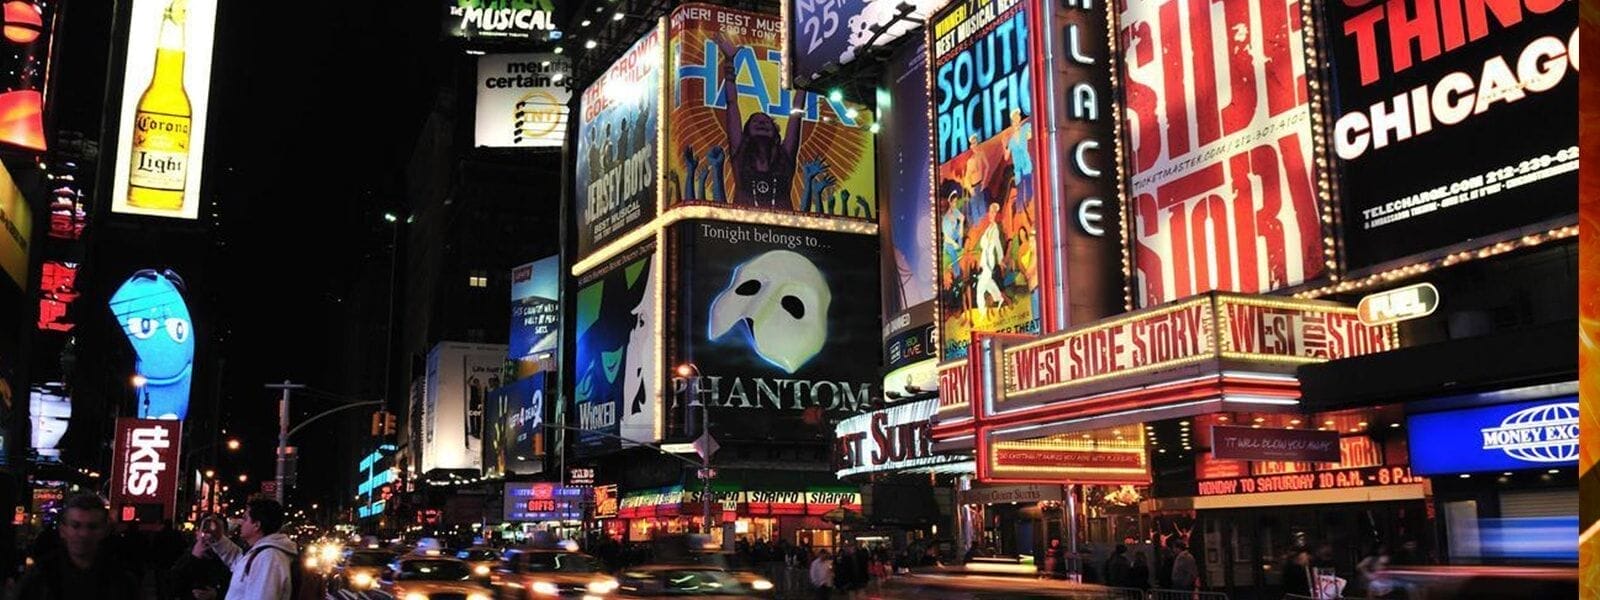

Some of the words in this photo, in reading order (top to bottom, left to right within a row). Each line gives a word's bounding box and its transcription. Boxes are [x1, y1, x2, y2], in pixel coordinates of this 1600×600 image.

[460, 6, 556, 31] MUSICAL
[717, 11, 751, 28] BEST
[720, 23, 748, 36] 2009
[752, 28, 777, 41] TONY
[935, 29, 956, 60] BEST
[957, 2, 997, 43] MUSICAL
[485, 74, 550, 89] certain
[508, 62, 549, 74] men
[673, 38, 859, 128] HAIR
[138, 151, 181, 174] Light
[585, 163, 623, 226] JERSEY
[624, 143, 653, 201] BOYS
[1362, 174, 1484, 220] TELECHARGE.COM
[1134, 132, 1322, 305] STORY
[701, 223, 750, 244] Tonight
[753, 228, 802, 249] belongs
[1225, 302, 1301, 356] WEST
[1015, 341, 1066, 393] WEST
[1069, 323, 1126, 379] SIDE
[1131, 310, 1201, 367] STORY
[671, 376, 872, 412] PHANTOM
[1483, 425, 1542, 447] MONEY
[1545, 424, 1579, 441] EXC
[127, 425, 170, 496] tkts
[1199, 479, 1237, 496] MONDAY
[1240, 477, 1256, 493] TO
[1257, 473, 1314, 492] SATURDAY
[1318, 471, 1334, 489] 10
[1379, 467, 1391, 485] 8
[527, 500, 556, 513] GIFTS
[751, 492, 798, 503] sbarro
[810, 492, 856, 504] sbarro
